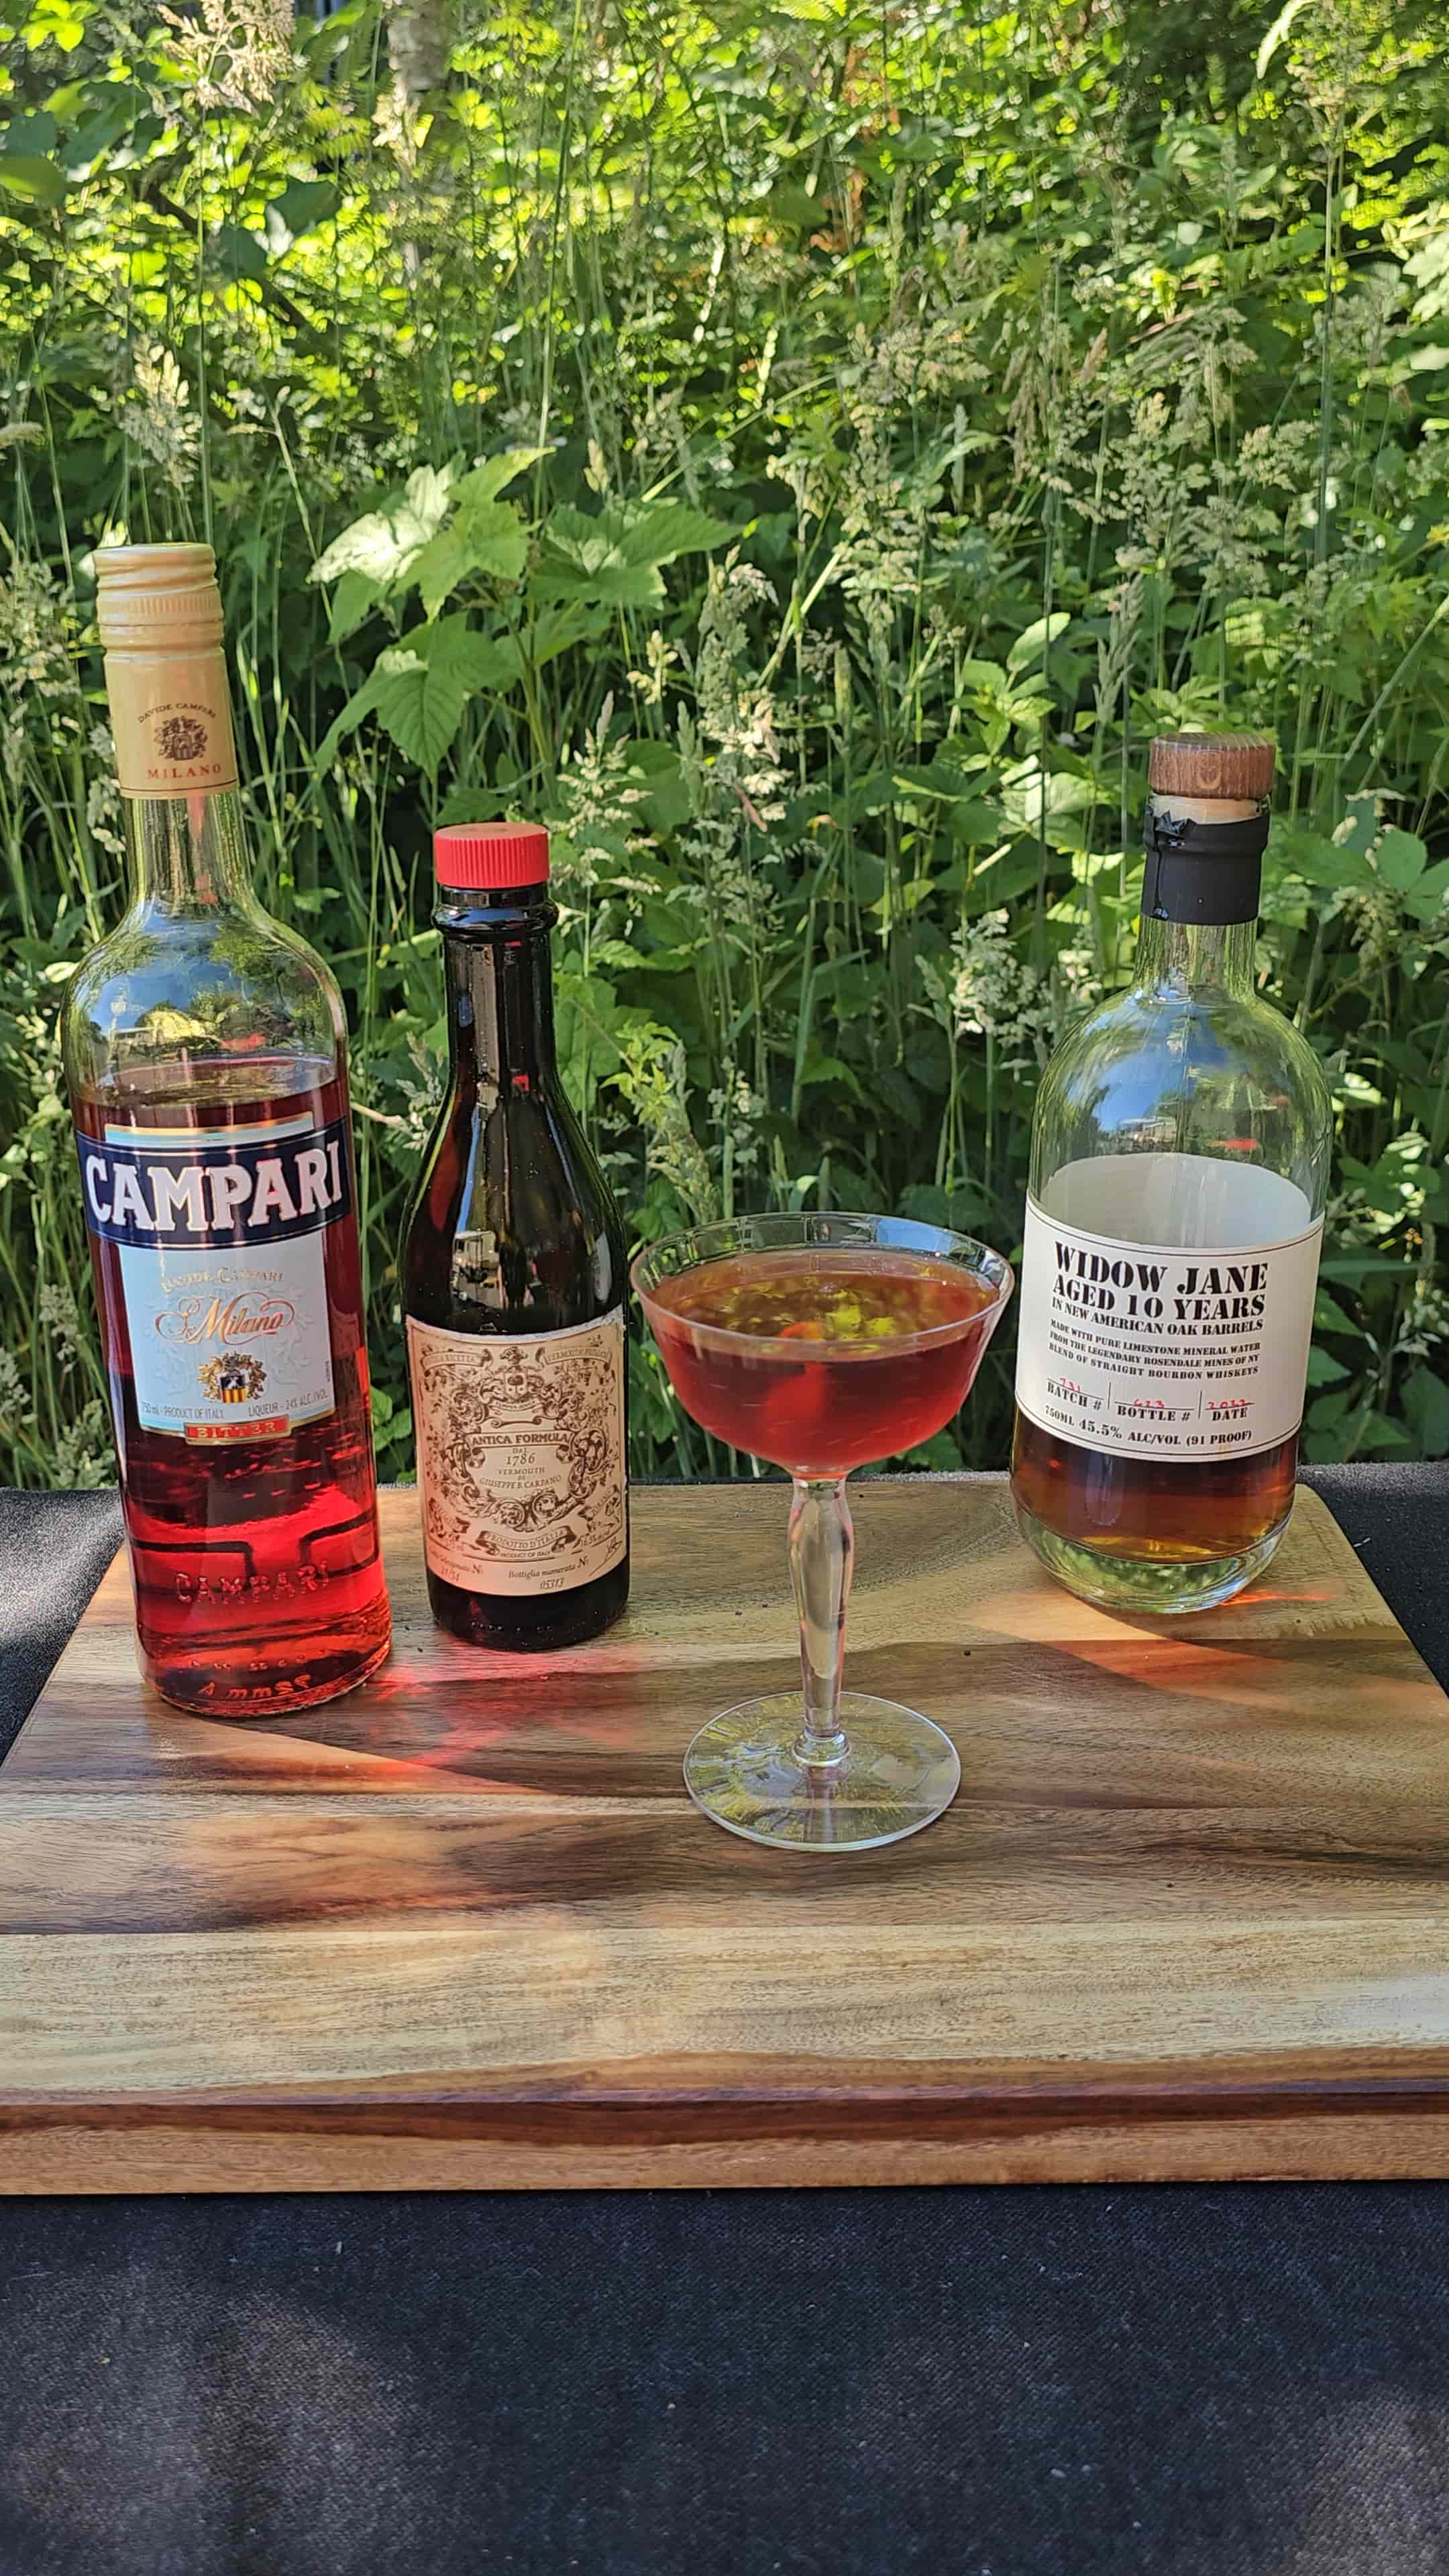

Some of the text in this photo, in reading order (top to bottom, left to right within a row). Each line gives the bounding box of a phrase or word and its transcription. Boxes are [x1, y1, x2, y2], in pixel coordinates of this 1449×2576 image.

[138, 703, 217, 723] DAVIDE CAMPARI
[147, 763, 221, 778] MILANO
[85, 1140, 343, 1232] CAMPARI
[1055, 1241, 1268, 1295] WIDOW JANE
[1053, 1274, 1265, 1320] AGED 10 YEARS
[180, 1292, 294, 1345] Milano
[1052, 1297, 1264, 1335] IN NEW AMERICAN OAK BARRELS
[1051, 1318, 1261, 1356] MADE WITH PURE LIMESTONE MINERAL WATER
[1049, 1330, 1260, 1367] FROM THE LEGENDARY ROSENDALE MINES OF NY
[1049, 1342, 1258, 1380] BLEND OF STRAIGHT BOURBON WHISKEYS
[1047, 1381, 1102, 1411] BATCH #
[164, 1405, 193, 1418] PRODUCT
[248, 1401, 279, 1417] LIQUEUR
[1117, 1405, 1191, 1421] BOTTLE #
[1212, 1407, 1248, 1421] DATE
[197, 1421, 276, 1438] BITTER
[1044, 1405, 1252, 1446] 750ML 45.5% ALC/VOL (91 PROOF)
[472, 1432, 570, 1446] ANTICA FORMULA
[506, 1453, 537, 1467] 1786
[498, 1466, 545, 1475] VERMOUTH
[525, 1474, 562, 1488] CARPANO
[175, 1560, 331, 1605] CAMPARI
[508, 1569, 540, 1579] Bottiglia
